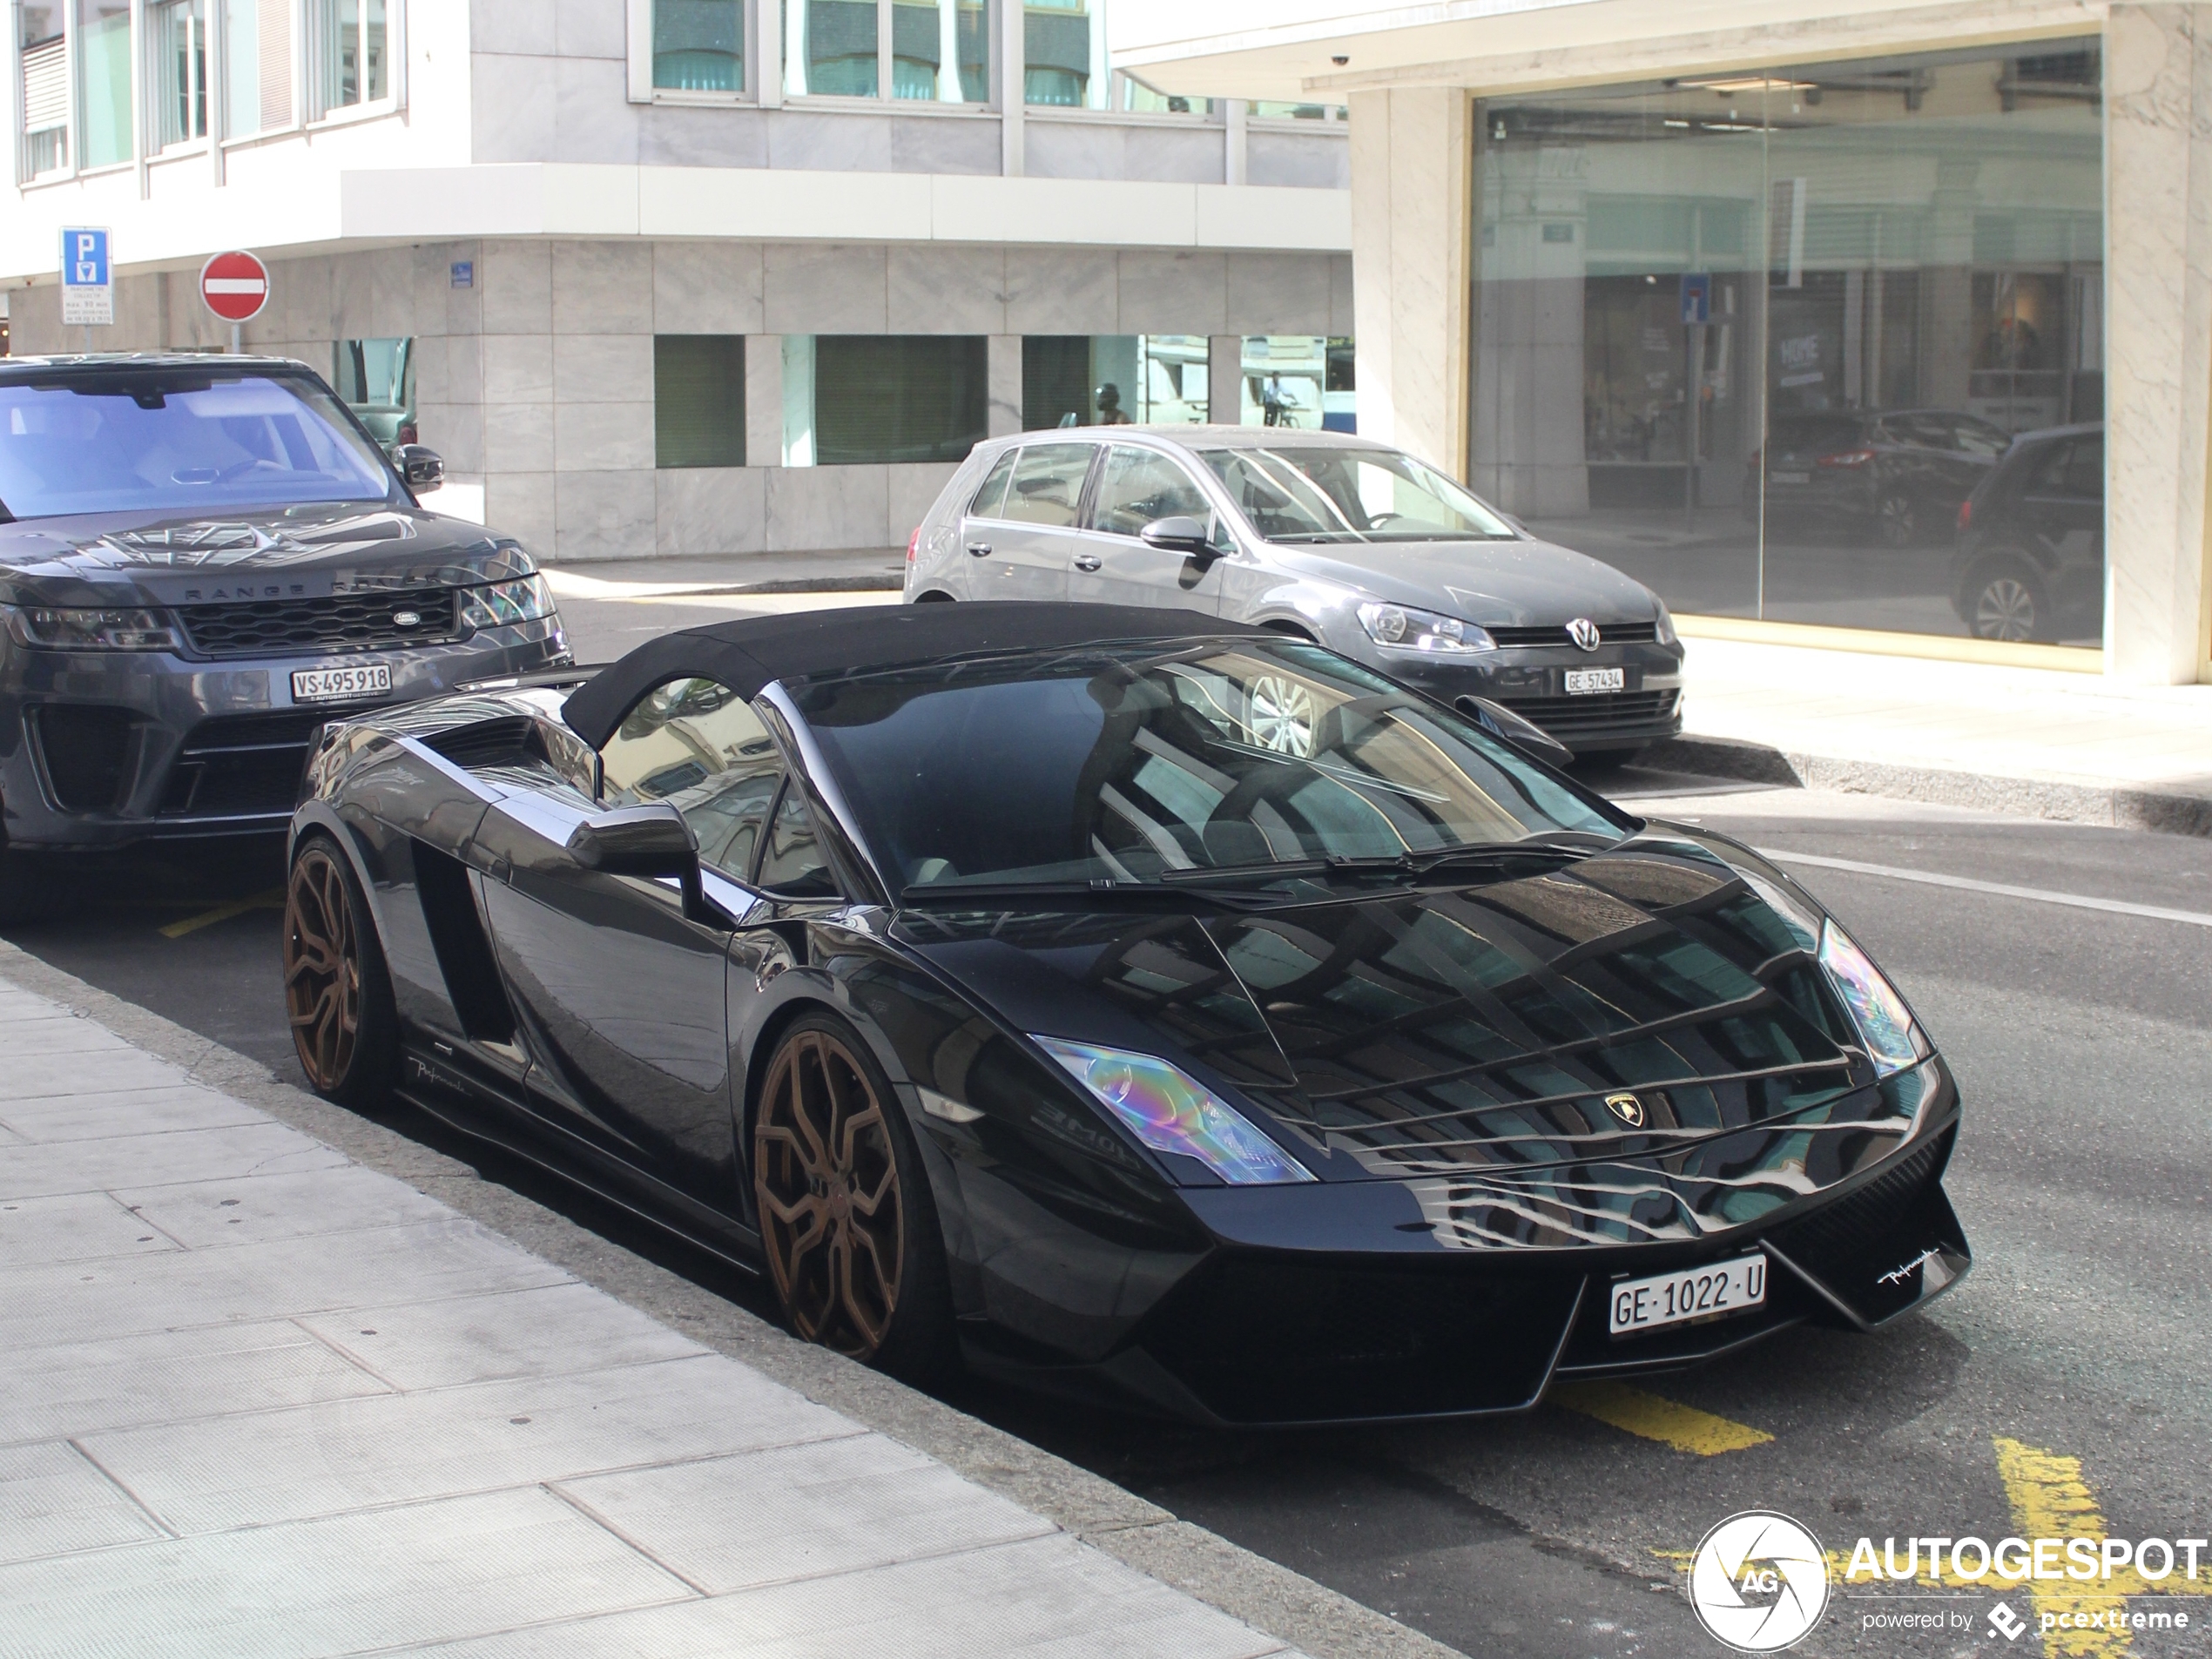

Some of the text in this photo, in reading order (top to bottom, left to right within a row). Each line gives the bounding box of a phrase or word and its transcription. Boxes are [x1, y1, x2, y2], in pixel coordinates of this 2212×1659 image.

[78, 233, 94, 260] P
[185, 573, 442, 601] RANGE ROVER
